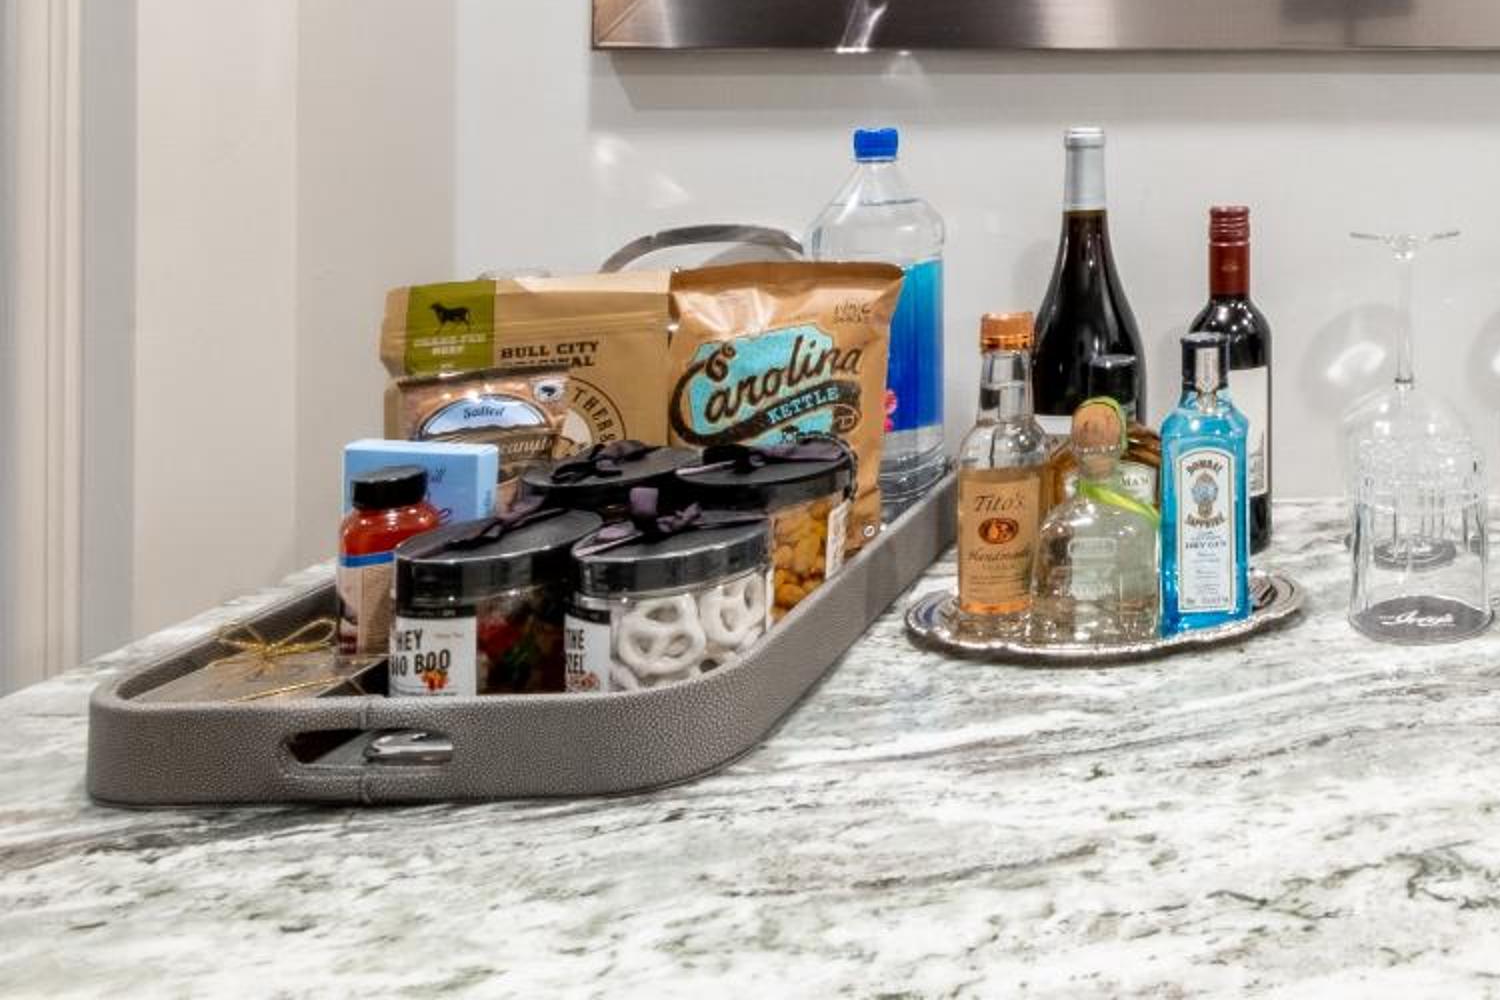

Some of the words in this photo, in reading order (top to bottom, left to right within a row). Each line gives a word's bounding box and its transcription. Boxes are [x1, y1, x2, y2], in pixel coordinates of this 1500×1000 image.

[500, 344, 550, 360] BULL
[556, 340, 600, 355] CITY
[671, 334, 864, 442] Carolina
[463, 405, 505, 420] Salted
[767, 387, 840, 424] KETTLE
[975, 490, 1025, 513] Tito's
[415, 649, 452, 674] BOO
